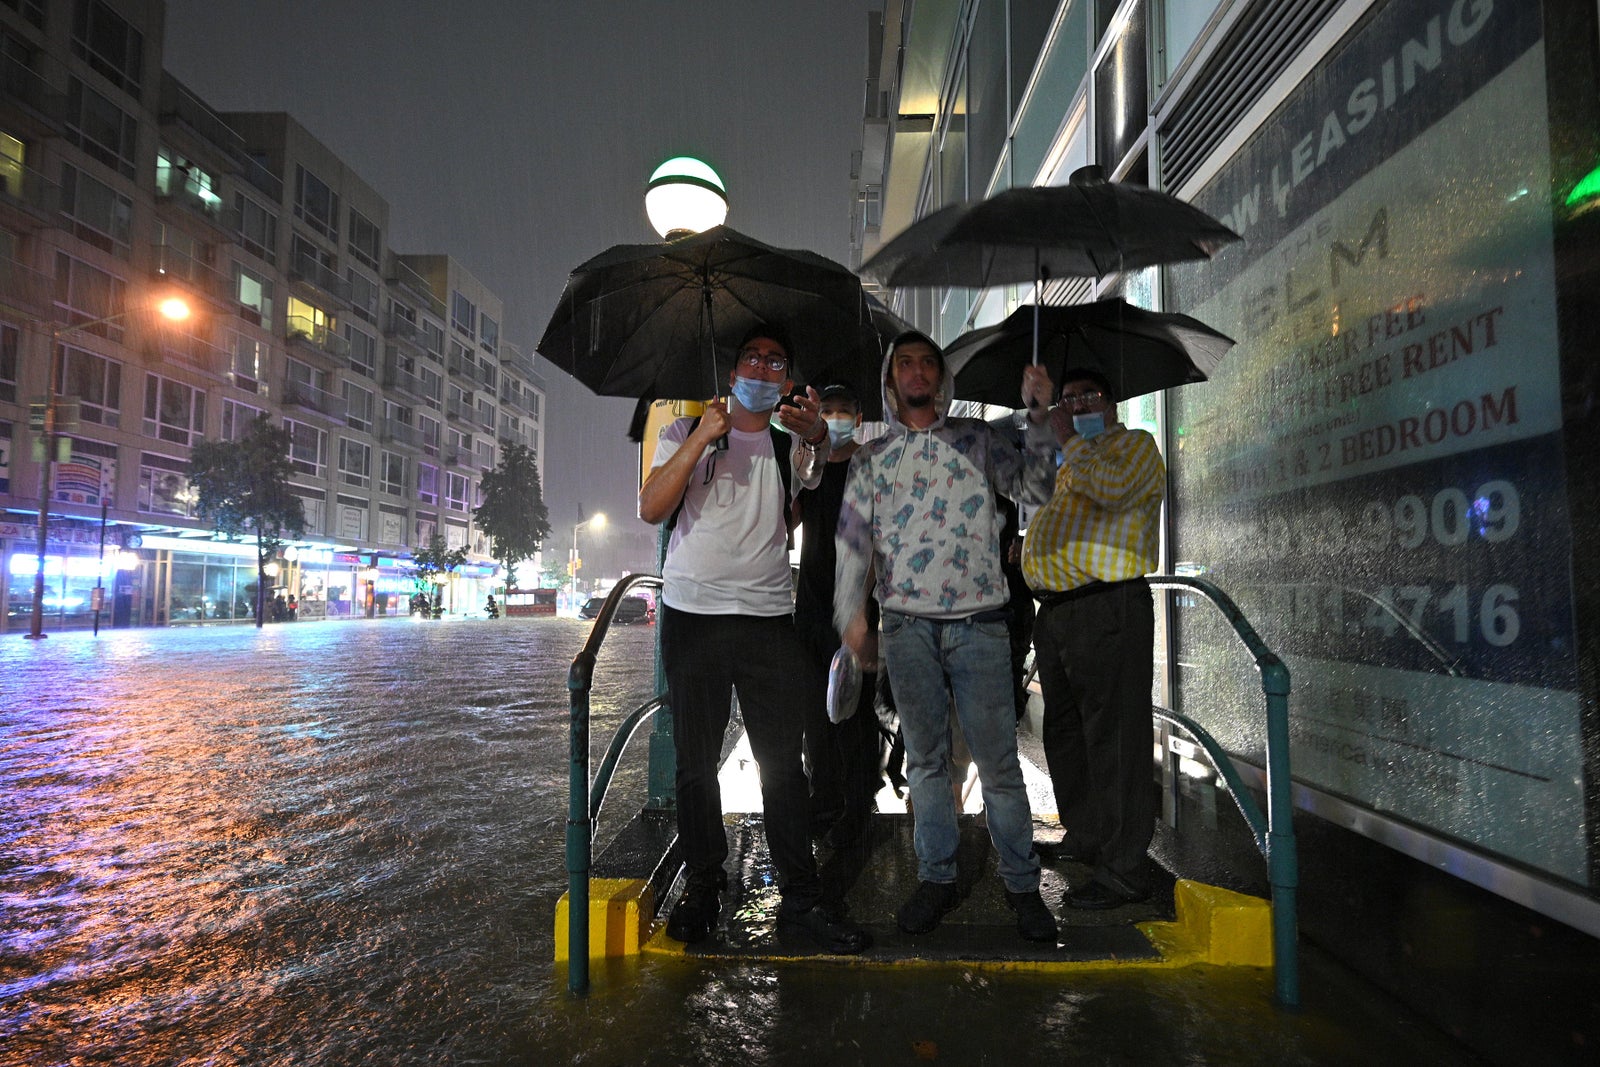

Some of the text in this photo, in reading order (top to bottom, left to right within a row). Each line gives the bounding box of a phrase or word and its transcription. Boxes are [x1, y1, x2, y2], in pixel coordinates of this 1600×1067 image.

[1269, 0, 1496, 217] LEASING
[1242, 204, 1390, 341] ELM
[1367, 293, 1427, 349] FEE
[1323, 353, 1393, 409] FREE
[1402, 305, 1505, 380] RENT
[1318, 441, 1333, 473] 2
[1341, 384, 1521, 468] BEDROOM
